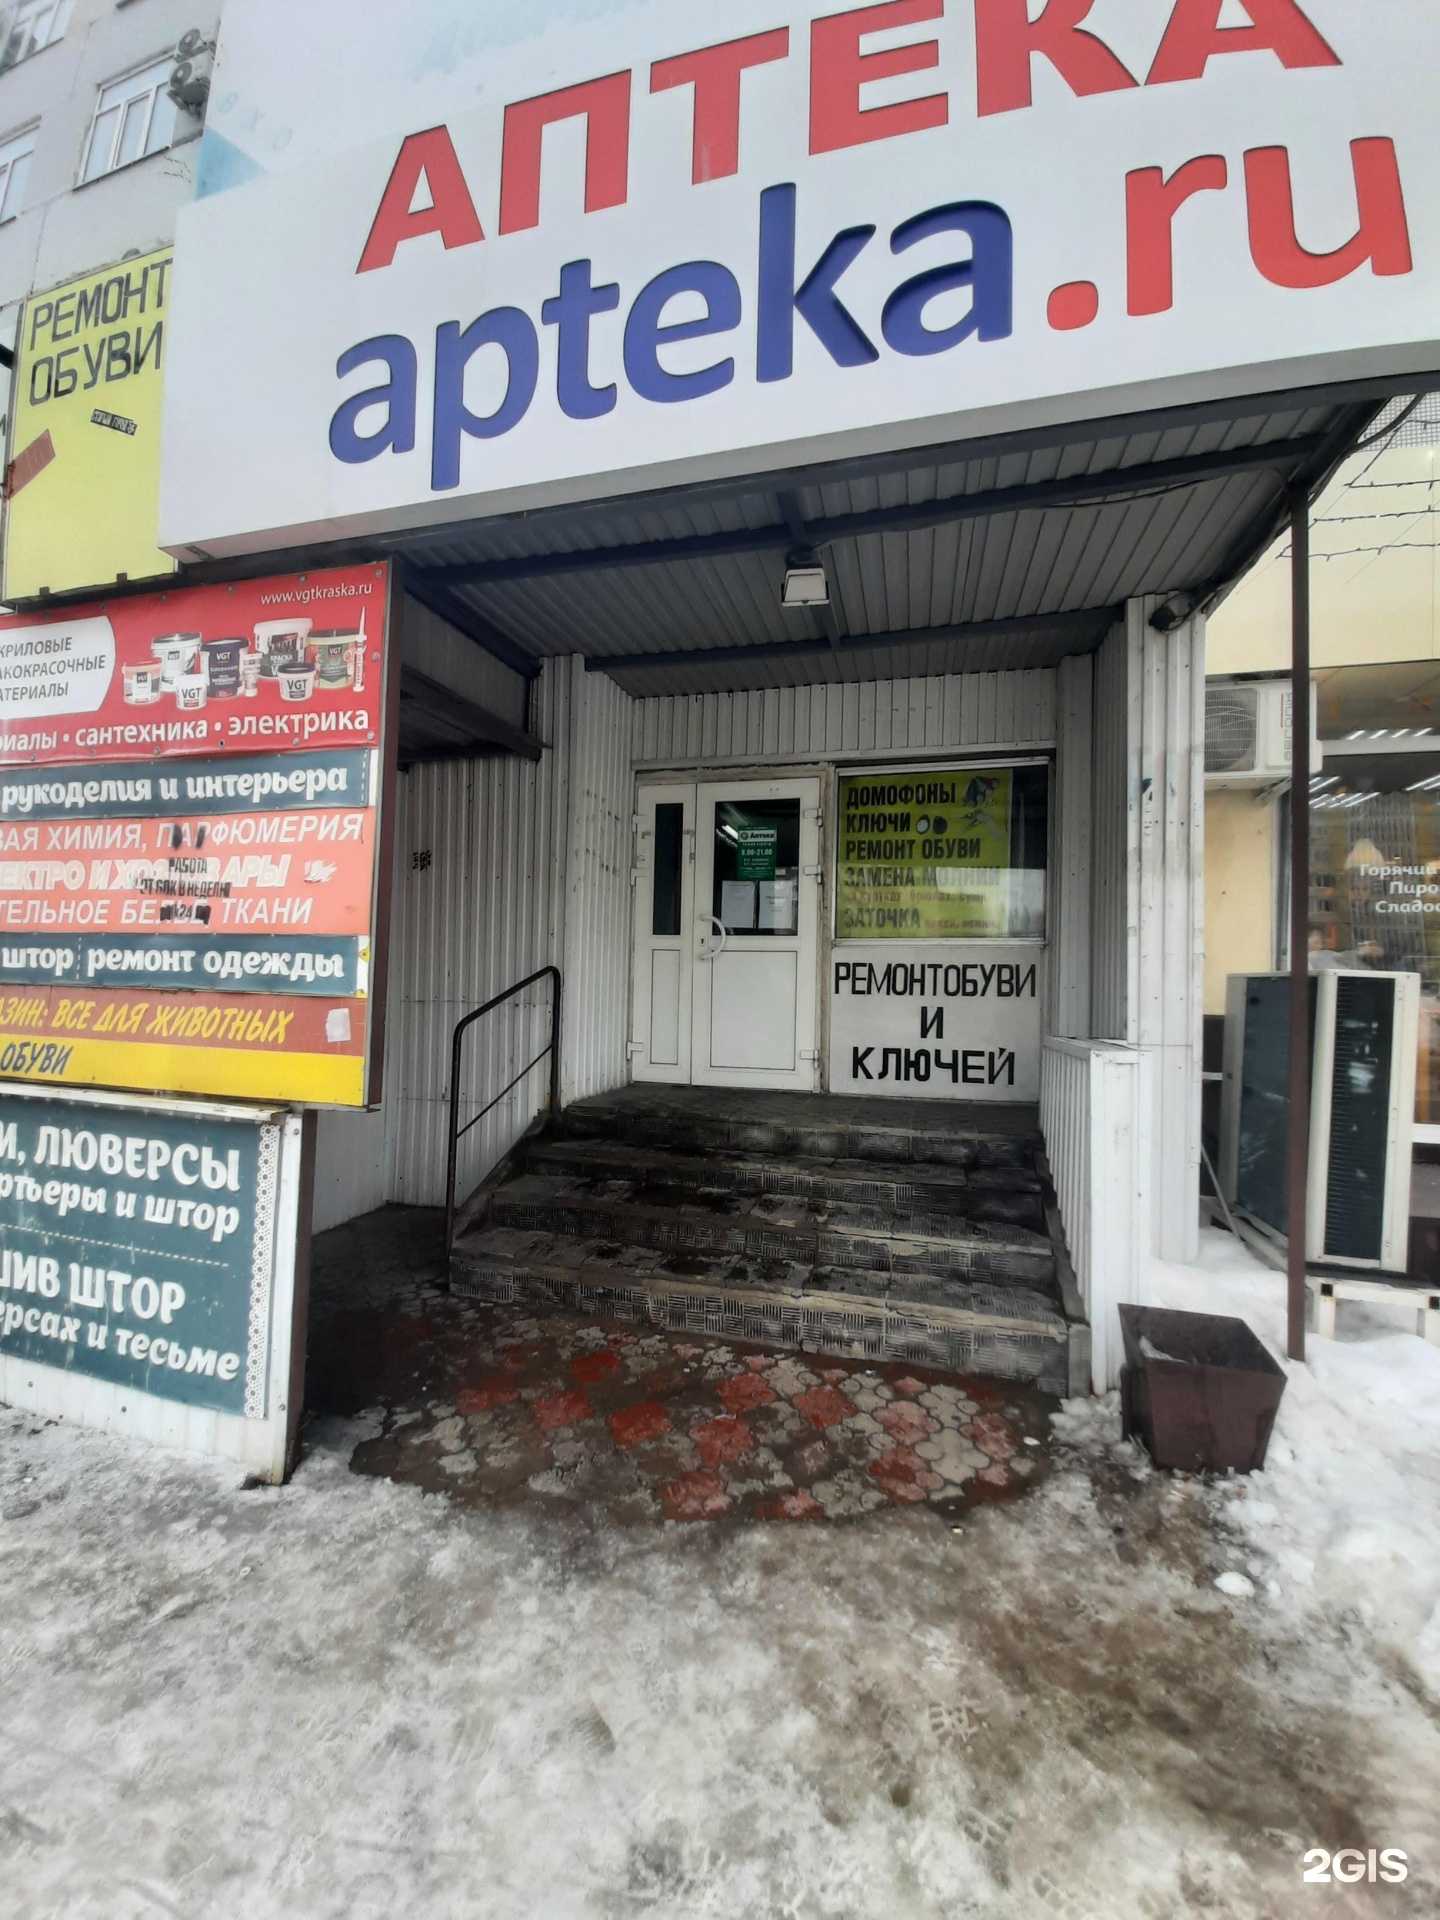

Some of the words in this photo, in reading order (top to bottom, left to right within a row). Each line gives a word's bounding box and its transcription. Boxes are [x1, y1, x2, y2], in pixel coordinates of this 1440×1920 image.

[356, 0, 1342, 274] АПТЕКА
[30, 258, 173, 351] РЕМОНТ
[328, 136, 1413, 491] apteka.ru
[29, 321, 164, 406] ОБУВИ
[261, 583, 373, 605] www.vgtkraska.ru
[181, 687, 202, 700] VGT
[286, 678, 308, 691] VGT
[75, 719, 208, 746] сантехника
[228, 709, 369, 739] электрика
[2, 779, 153, 813] рукоделия
[159, 778, 178, 800] и
[187, 767, 348, 803] интерьера
[847, 783, 957, 810] ДОМОФОНЫ
[46, 823, 147, 852] ХИМИЯ,
[846, 812, 912, 833] КЛЮЧИ
[168, 857, 208, 874] РАБОТА
[845, 838, 916, 860] РЕМОНТ
[922, 837, 981, 859] ОБУВИ
[845, 866, 915, 887] ЗАМЕНА
[222, 897, 313, 925] ТКАНИ
[844, 908, 920, 929] ЗАТОЧКА
[2, 946, 73, 976] штор
[88, 946, 196, 977] ремонт
[203, 949, 345, 982] одежды
[51, 999, 96, 1030] ВСЕ
[92, 1002, 150, 1034] ДЛЯ
[147, 1004, 295, 1044] ЖИВОТНЫХ
[920, 1006, 944, 1039] И
[0, 1041, 74, 1075] ОБУВИ
[852, 1046, 1016, 1085] КЛЮЧЕЙ
[34, 1125, 241, 1193] ЛЮВЕРСЫ
[115, 1190, 136, 1219] и
[144, 1194, 241, 1242] штор
[69, 1262, 186, 1324] ШТОР
[87, 1321, 108, 1350] и
[115, 1327, 241, 1381] тесьме
